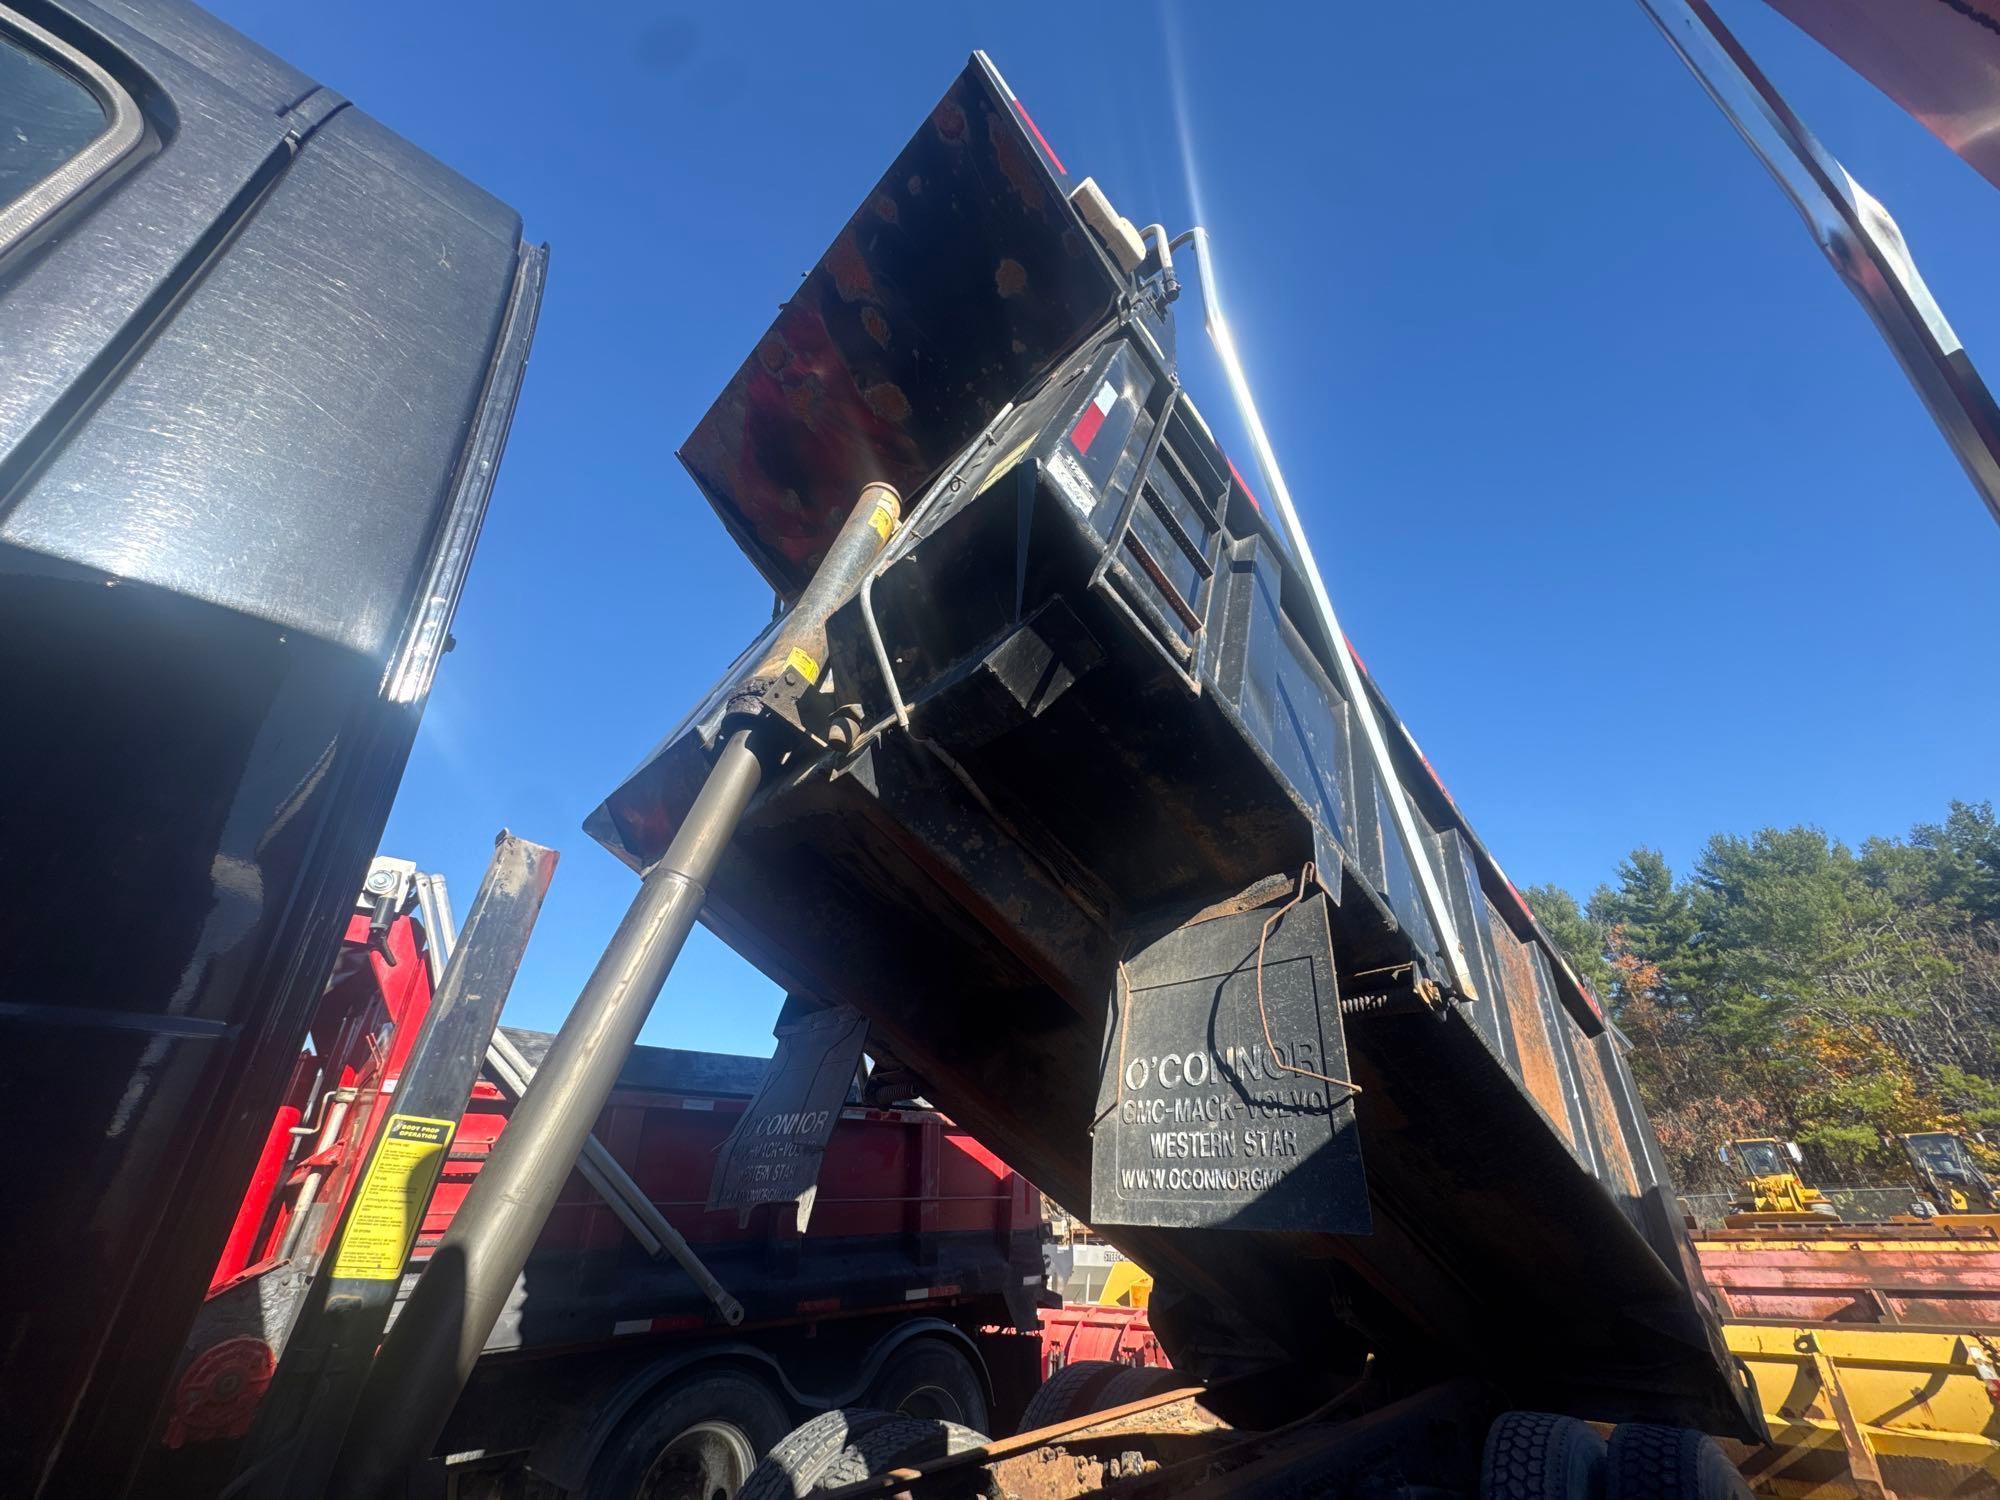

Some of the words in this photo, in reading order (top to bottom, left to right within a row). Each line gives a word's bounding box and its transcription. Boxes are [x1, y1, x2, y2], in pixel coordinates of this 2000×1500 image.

[1125, 1038, 1321, 1091] O'CONNOR
[1121, 1088, 1328, 1124] GMC-MACK-VOLVO
[399, 1130, 438, 1140] OPERATION
[743, 1111, 829, 1138] OCONNOR
[1150, 1131, 1236, 1159] WESTERN
[1244, 1127, 1298, 1158] STAR
